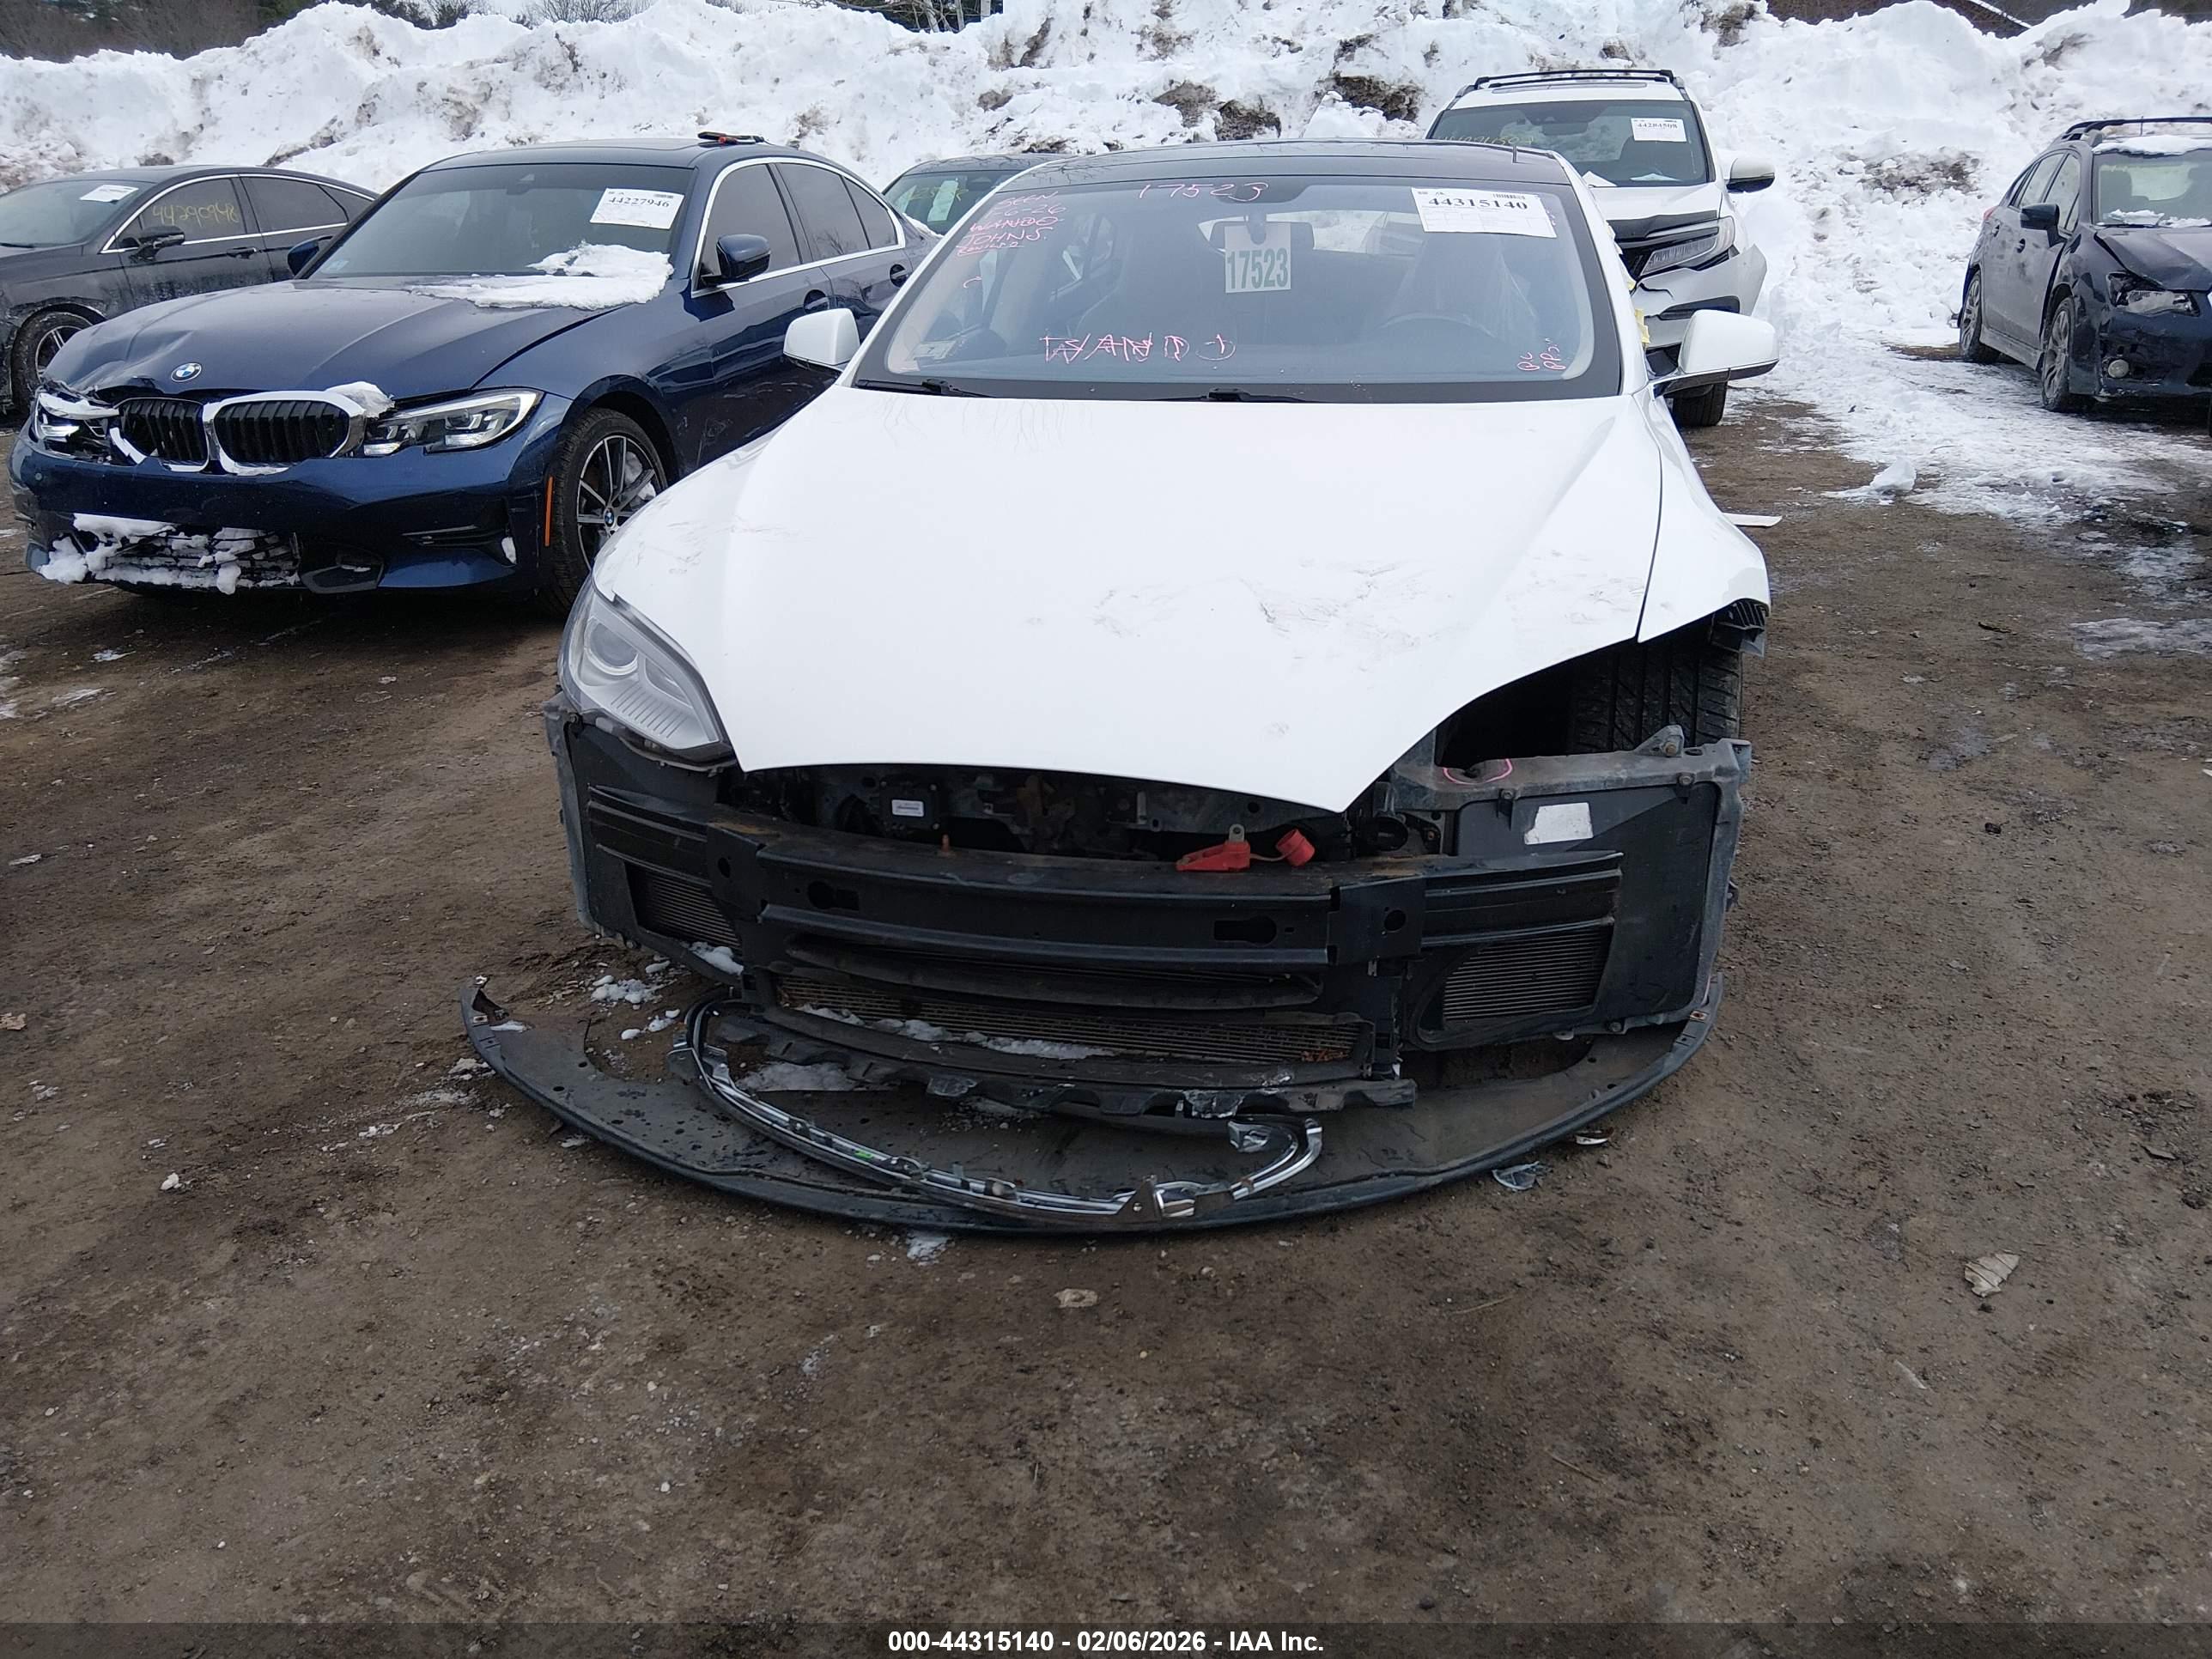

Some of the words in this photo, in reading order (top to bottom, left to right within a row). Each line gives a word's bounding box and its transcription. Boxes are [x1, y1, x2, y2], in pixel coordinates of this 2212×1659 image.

[608, 196, 671, 208] 44227946
[1139, 181, 1269, 202] 17523
[1428, 197, 1528, 210] 44315140
[152, 202, 240, 228] 44290948
[1226, 247, 1289, 289] 17523
